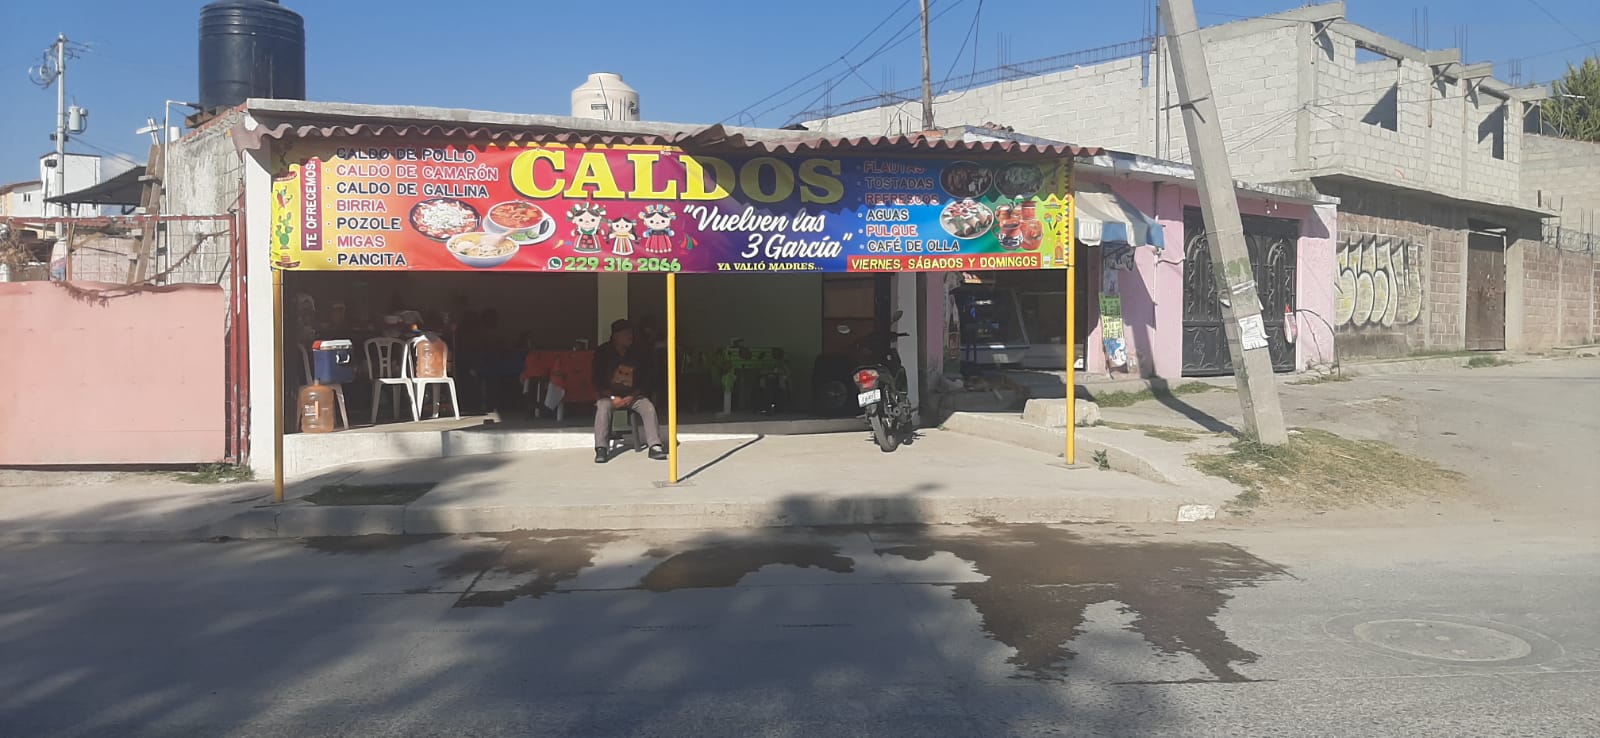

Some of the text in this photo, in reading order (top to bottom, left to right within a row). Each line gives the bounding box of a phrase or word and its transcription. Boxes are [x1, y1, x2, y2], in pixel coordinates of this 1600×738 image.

[336, 147, 474, 162] CALDO DE POLLO
[336, 164, 498, 180] CALDO DE CAMARÓN
[511, 149, 844, 204] CALDOS
[336, 182, 488, 197] CALDO DE GALLINA
[865, 177, 934, 190] TOSTADAS
[336, 200, 386, 211] BIRRIA
[865, 193, 940, 205] REFRESCOS
[792, 208, 826, 232] las
[866, 209, 909, 221] AGUAS
[336, 217, 401, 230] POZOLE
[867, 225, 917, 237] PULQUE
[305, 233, 317, 248] TE
[337, 236, 385, 247] MIGAS
[741, 234, 764, 258] 3
[868, 238, 959, 252] CAFÉ DE OLLA
[337, 253, 406, 265] PANCITA
[564, 257, 681, 272] 229 316 2066
[717, 262, 731, 270] YA
[734, 260, 765, 271] VALIÓ
[852, 255, 1038, 270] VIERNES, SÁBADOS Y DOMINGOS
